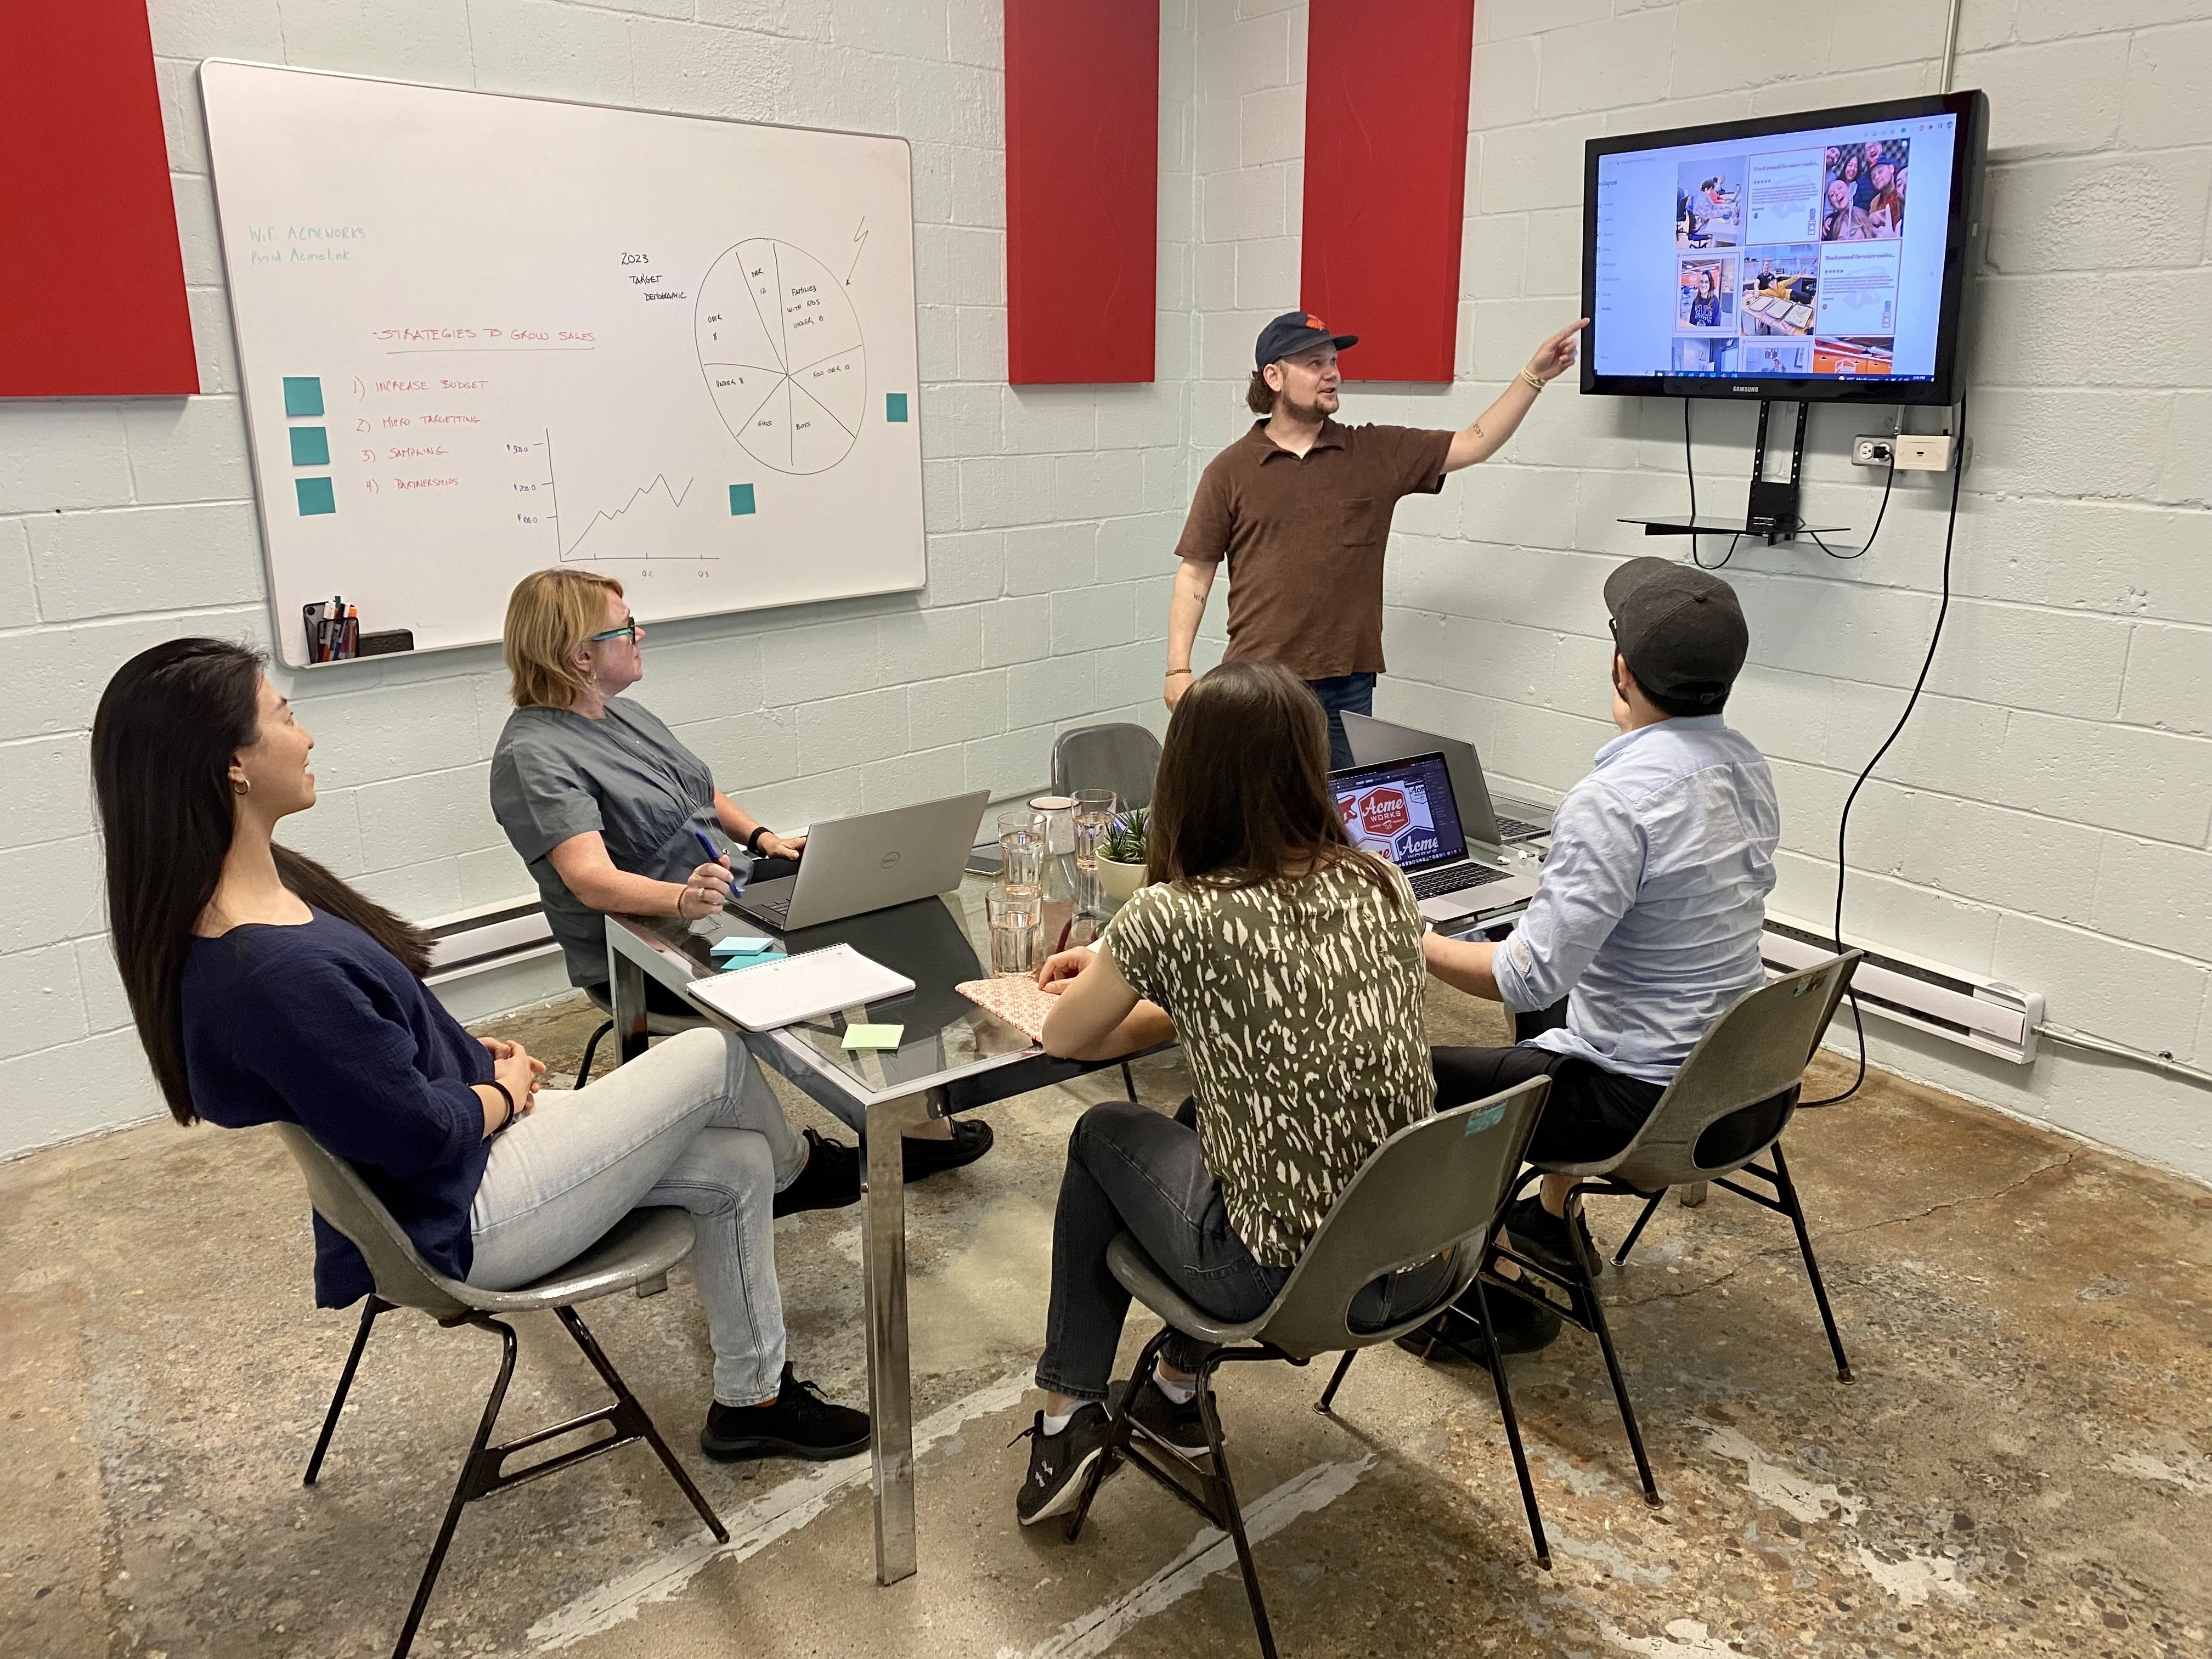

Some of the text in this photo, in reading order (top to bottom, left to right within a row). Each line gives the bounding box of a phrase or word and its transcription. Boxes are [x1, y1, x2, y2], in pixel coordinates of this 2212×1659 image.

[621, 252, 648, 265] 2023
[629, 273, 662, 285] TARGET
[787, 304, 801, 313] WITH
[708, 314, 722, 323] OVER
[793, 317, 814, 329] UNDER
[483, 329, 502, 338] TO
[511, 331, 549, 340] GROW
[559, 331, 595, 341] SALES
[713, 332, 717, 341] 8
[353, 375, 488, 402] 1) INCREASE BUDGET
[716, 380, 736, 388] UNDER
[356, 415, 481, 433] 2) MICRO TARGETTING
[362, 447, 448, 462] 3) SAMPLING
[366, 479, 379, 493] 4)
[1410, 785, 1425, 795] Acm
[1362, 797, 1404, 817] Acme
[1370, 810, 1401, 822] WORKS
[1399, 836, 1439, 860] Acme
